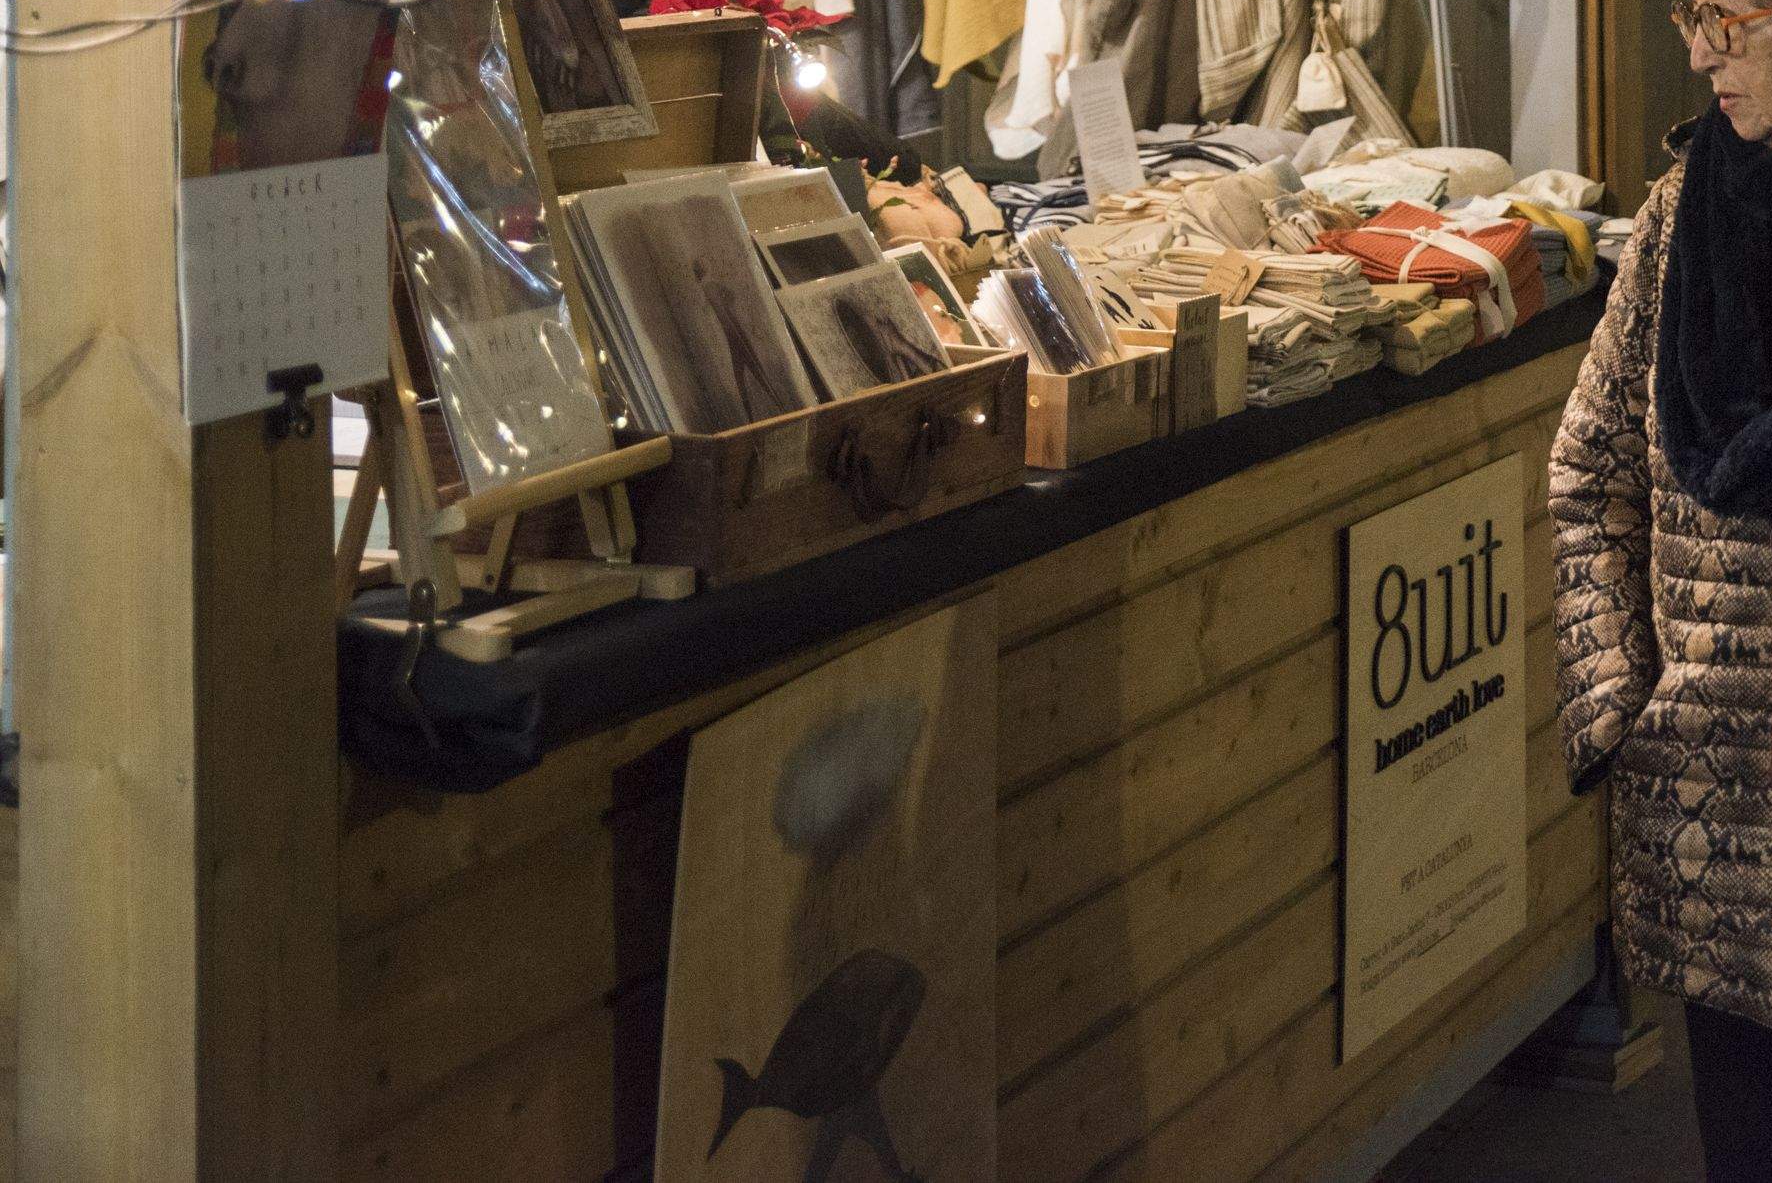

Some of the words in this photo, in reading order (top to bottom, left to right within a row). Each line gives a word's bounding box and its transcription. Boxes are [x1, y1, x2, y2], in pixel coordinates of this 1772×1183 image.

[1371, 519, 1508, 709] 8uit
[1374, 722, 1425, 774] home
[1425, 689, 1470, 741] earth
[1471, 673, 1506, 711] love
